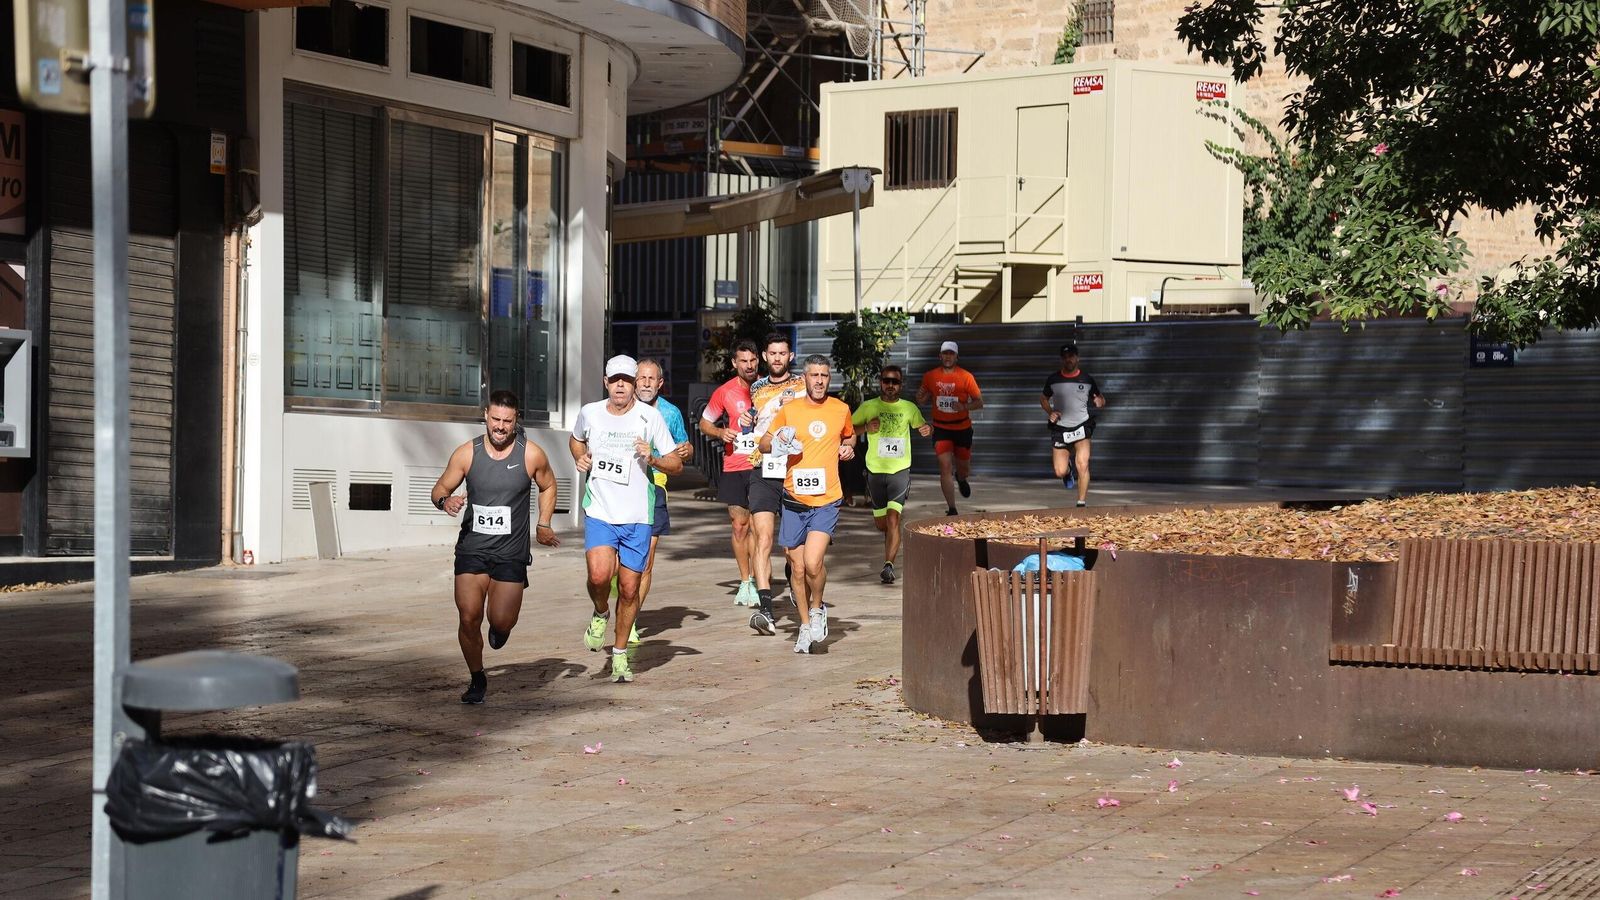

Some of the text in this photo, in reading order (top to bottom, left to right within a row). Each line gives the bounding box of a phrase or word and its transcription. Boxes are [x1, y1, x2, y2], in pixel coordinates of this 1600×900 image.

[1074, 76, 1103, 87] REMSA
[1197, 81, 1225, 93] REMSA
[1073, 275, 1102, 285] REMSA
[742, 440, 755, 448] 13
[885, 444, 898, 452] 14
[598, 460, 623, 474] 975
[796, 477, 820, 487] 839
[478, 515, 504, 526] 614
